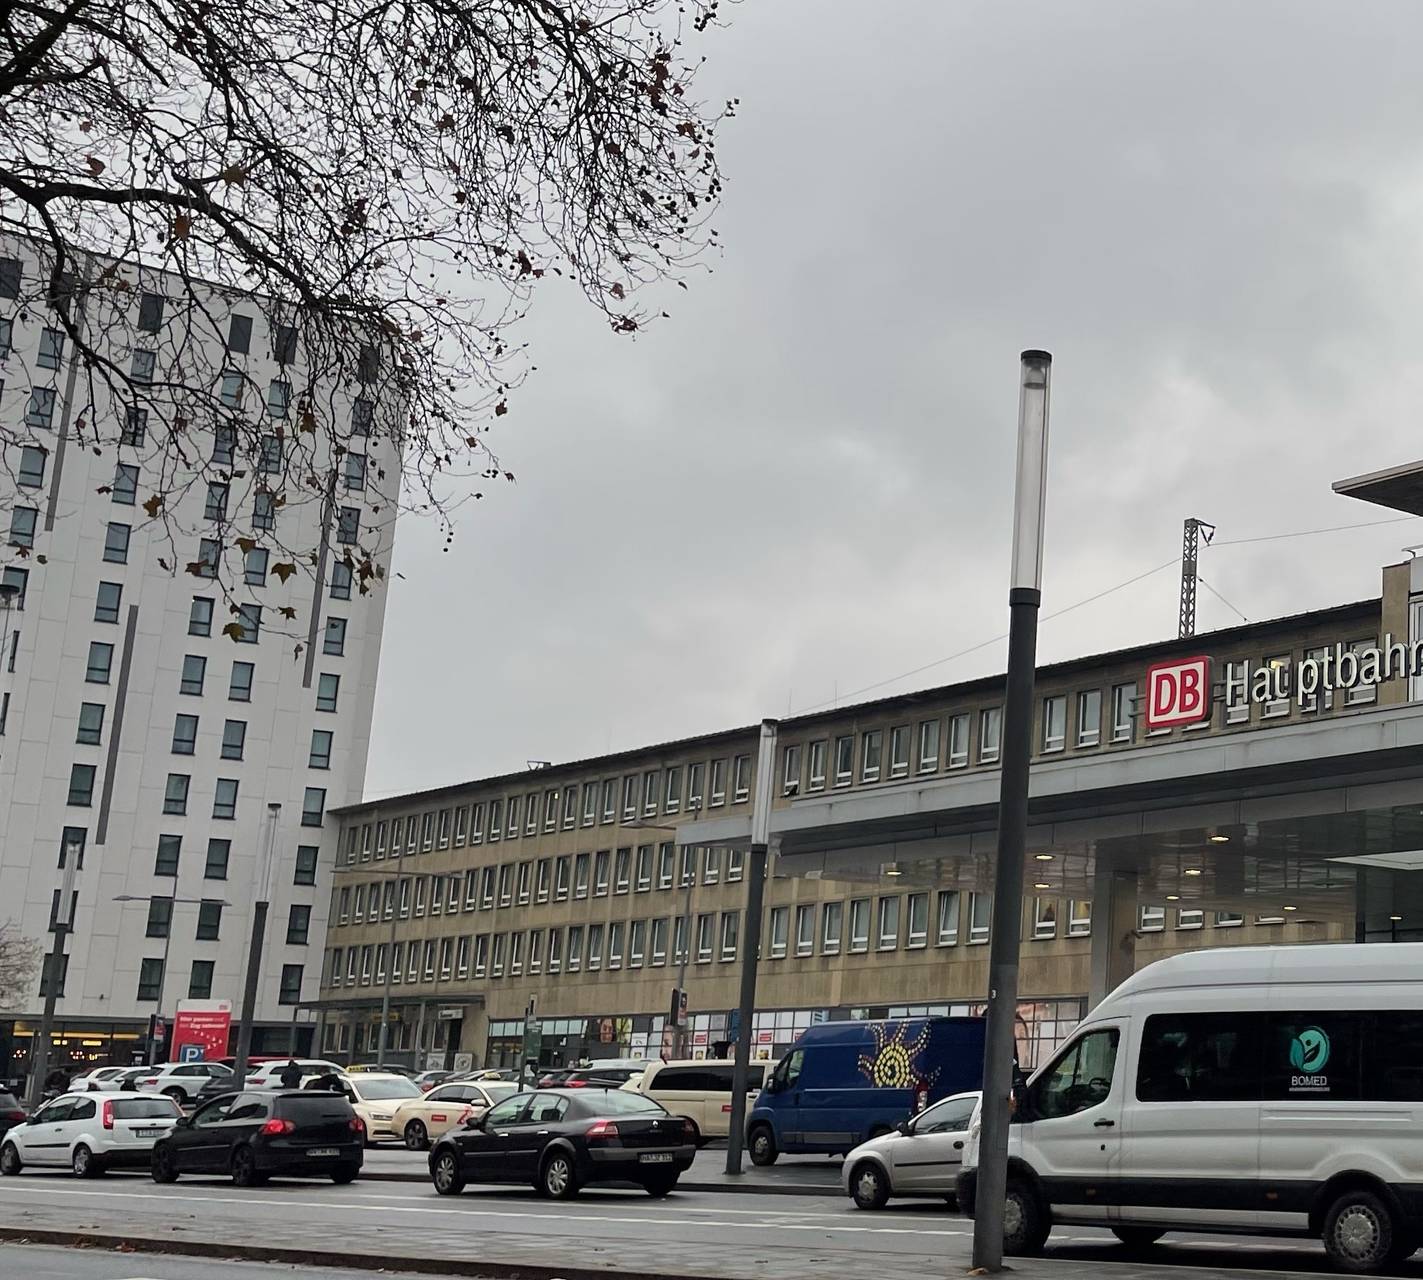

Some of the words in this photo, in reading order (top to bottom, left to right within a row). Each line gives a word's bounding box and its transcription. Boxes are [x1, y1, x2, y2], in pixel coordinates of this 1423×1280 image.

[1154, 669, 1200, 717] DB
[991, 989, 997, 999] 3
[186, 1048, 199, 1062] P
[1291, 1075, 1328, 1086] BOMED
